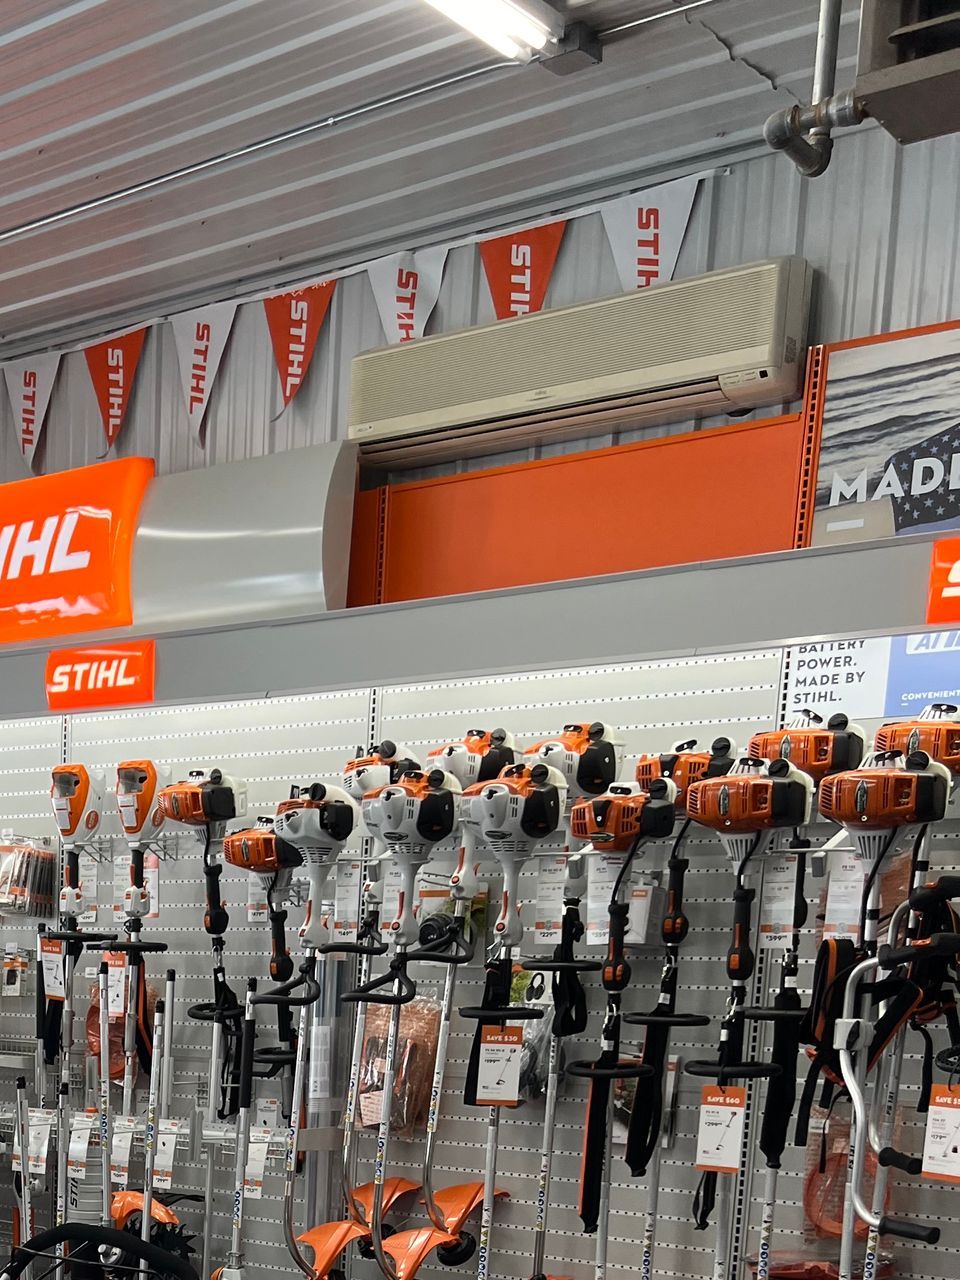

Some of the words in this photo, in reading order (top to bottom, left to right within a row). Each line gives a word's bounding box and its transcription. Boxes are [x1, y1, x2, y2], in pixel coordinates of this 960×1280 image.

[637, 207, 660, 289] STIH
[396, 267, 418, 343] STIH
[510, 243, 531, 317] STIH
[190, 322, 211, 414] STIHL
[285, 299, 308, 397] STIHL
[22, 370, 37, 454] STIHL
[107, 348, 123, 437] STIHL
[51, 658, 136, 692] STIHL
[795, 673, 840, 688] MADE
[845, 670, 866, 684] BY
[797, 656, 858, 672] POWER.
[793, 690, 842, 705] STIHL.
[901, 689, 960, 701] CONVENIENT
[487, 1034, 502, 1042] SAVE
[935, 1096, 952, 1104] SAVE
